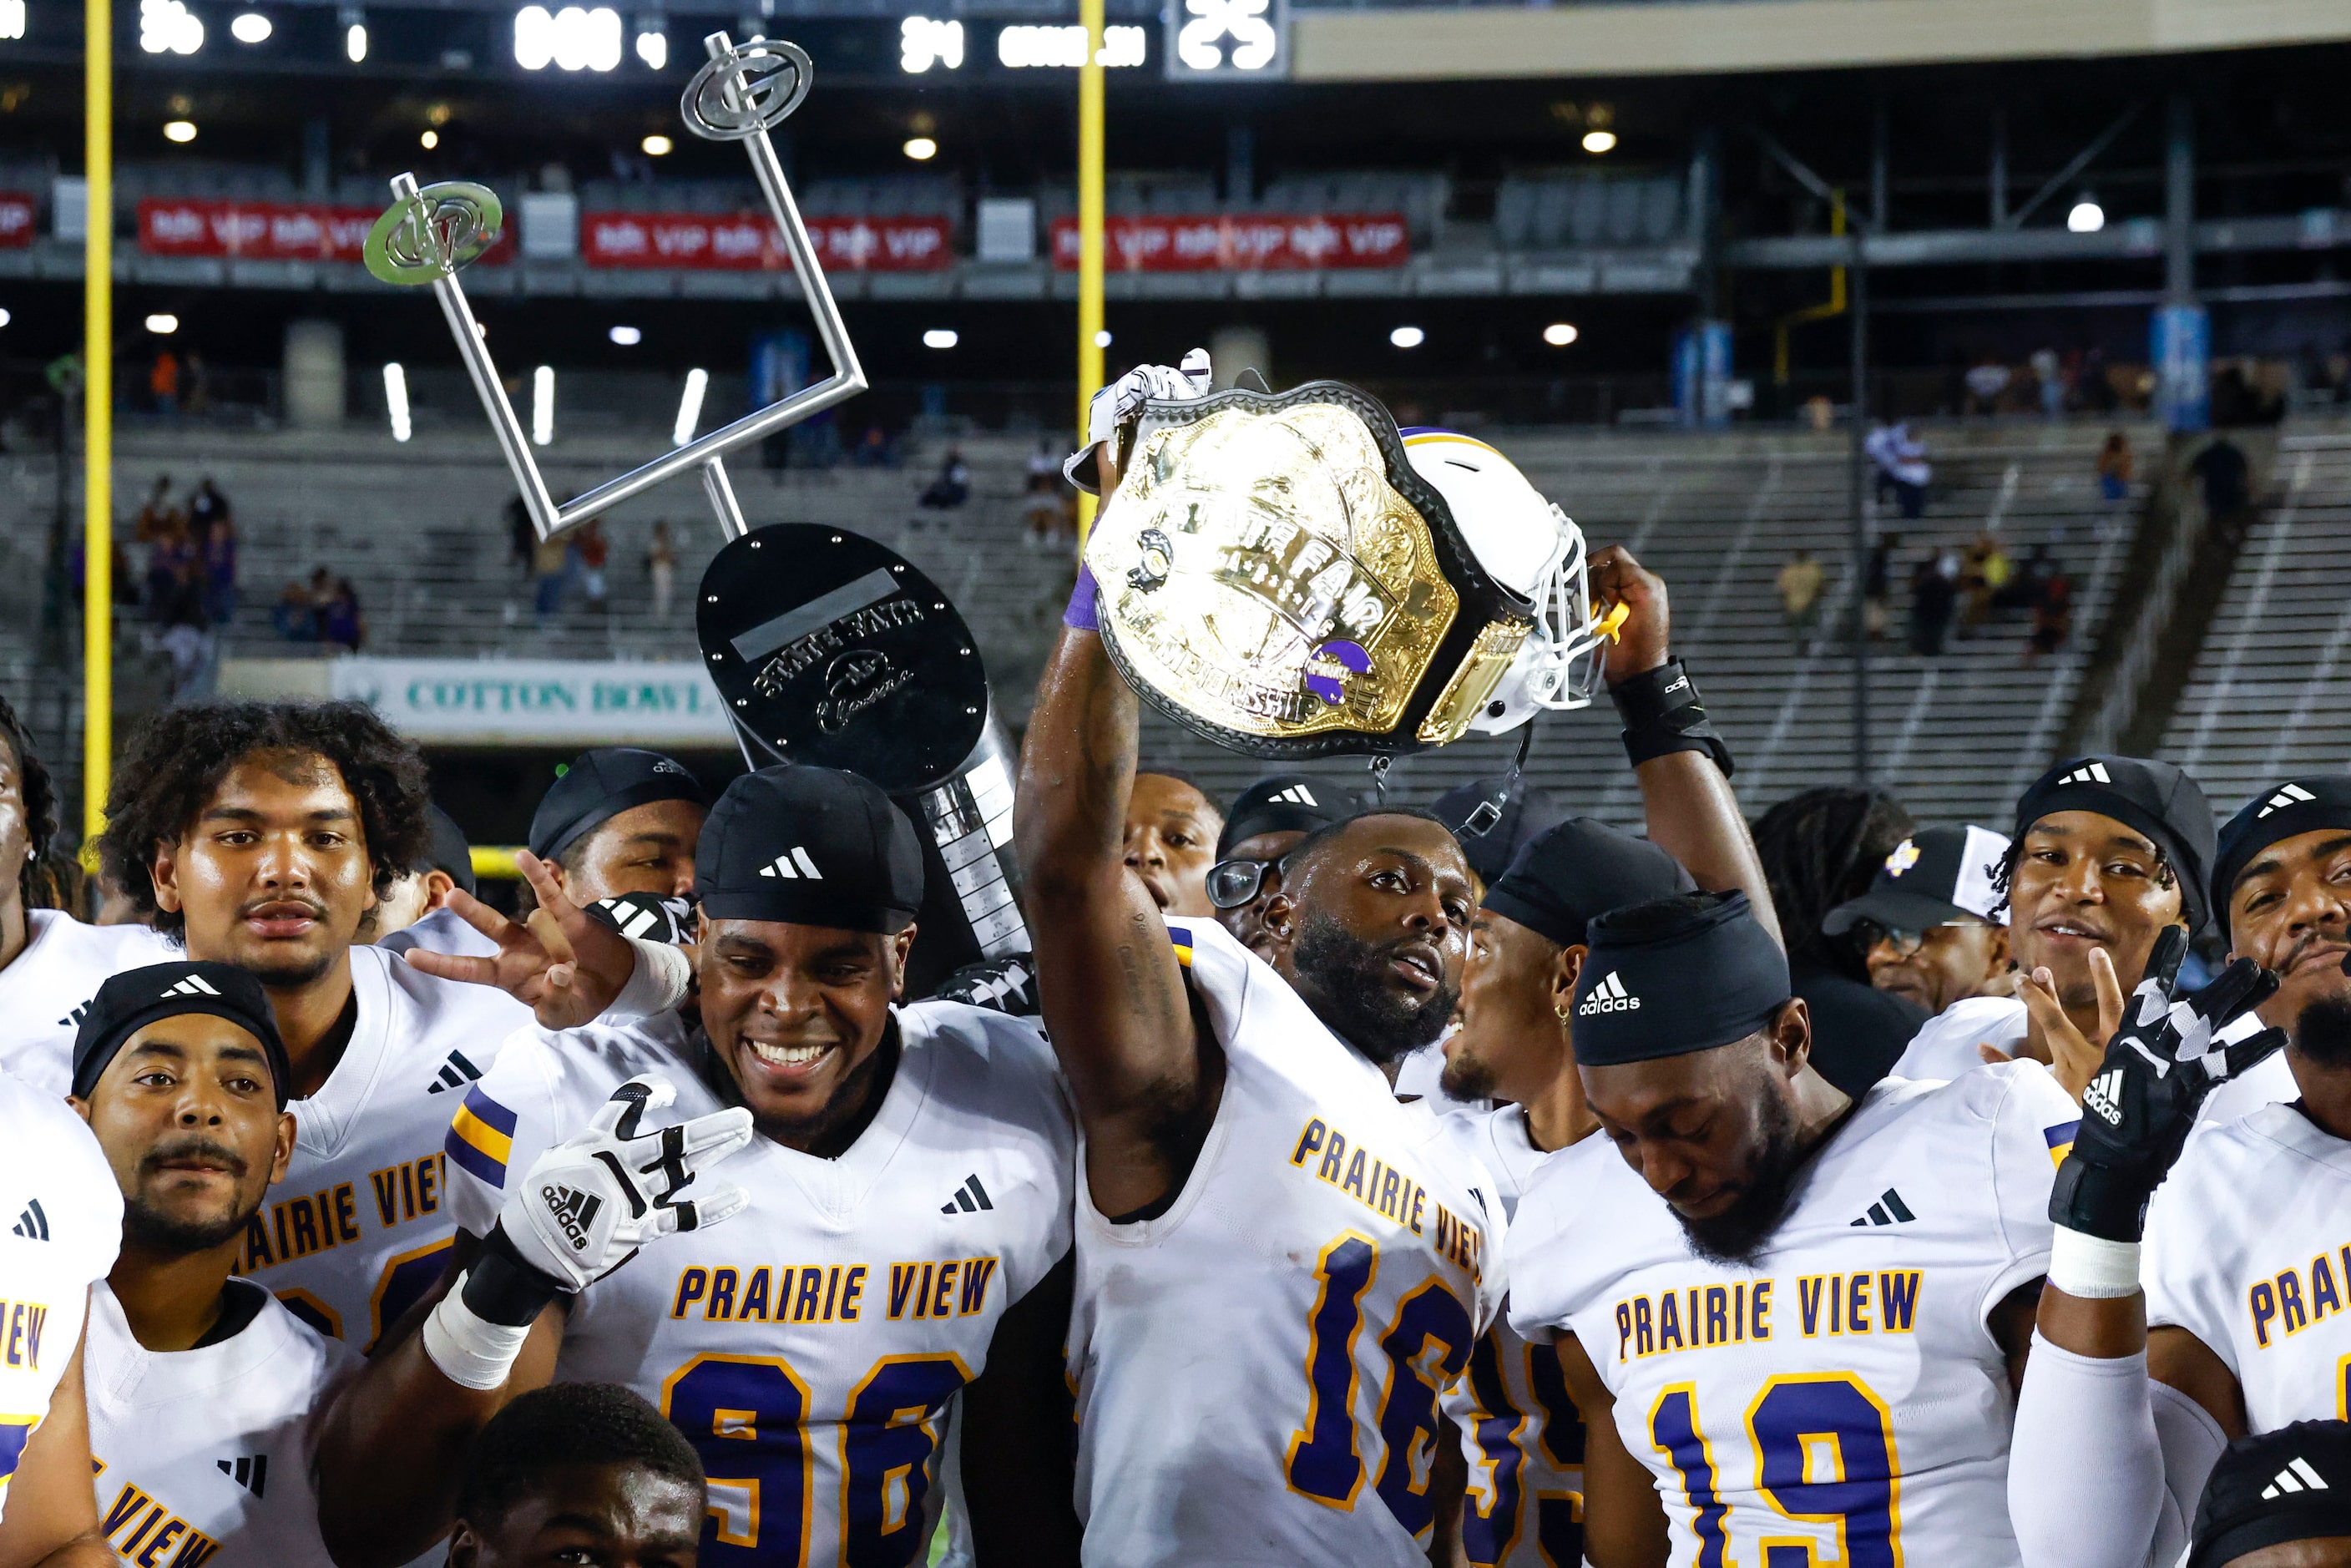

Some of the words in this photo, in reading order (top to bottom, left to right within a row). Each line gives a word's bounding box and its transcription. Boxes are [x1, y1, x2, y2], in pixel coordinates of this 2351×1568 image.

[406, 679, 577, 713] COTTON
[1575, 996, 1641, 1016] adidas
[2082, 1085, 2122, 1125] adidas
[368, 1150, 446, 1229] VIE
[1289, 1114, 1428, 1238] PRAIRIE
[542, 1185, 588, 1251] adidas
[670, 1263, 869, 1324] PRAIRIE
[885, 1255, 999, 1322] VIEW
[1615, 1278, 1774, 1365] PRAIRIE
[1796, 1268, 1924, 1339] VIEW
[1286, 1227, 1475, 1540] 16
[1646, 1369, 1903, 1568] 19
[102, 1480, 225, 1568] VIEW
